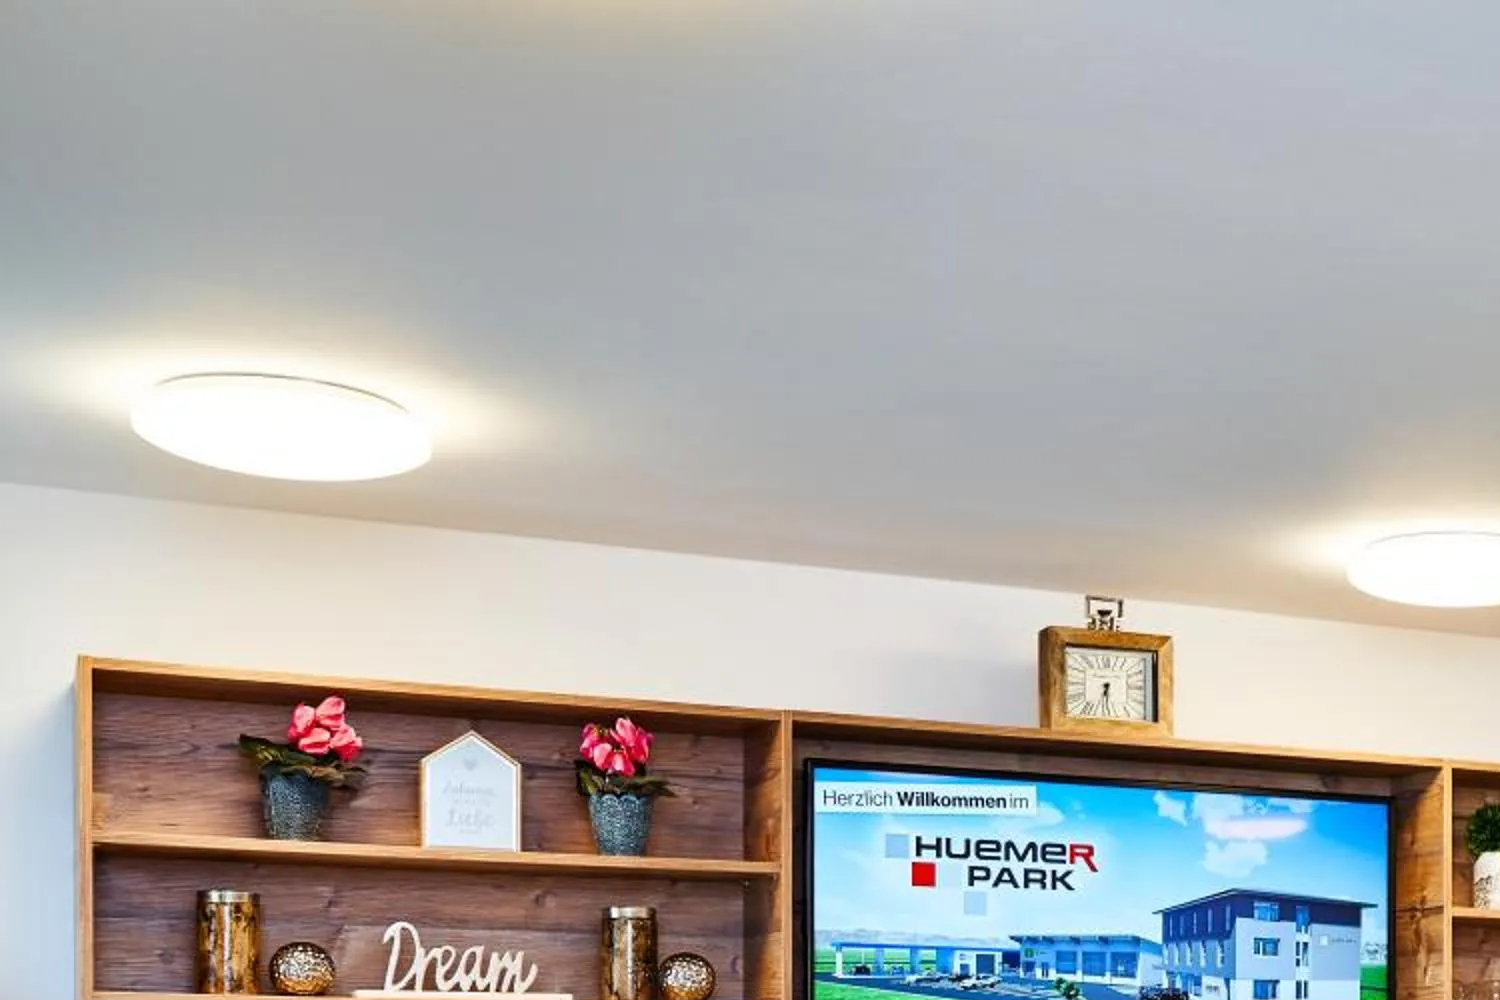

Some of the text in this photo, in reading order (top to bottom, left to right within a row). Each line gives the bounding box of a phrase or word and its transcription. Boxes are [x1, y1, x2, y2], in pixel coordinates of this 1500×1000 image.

[822, 789, 1029, 809] Herzlich Willkommen im
[967, 865, 1075, 890] PARK
[382, 921, 538, 993] Dream
